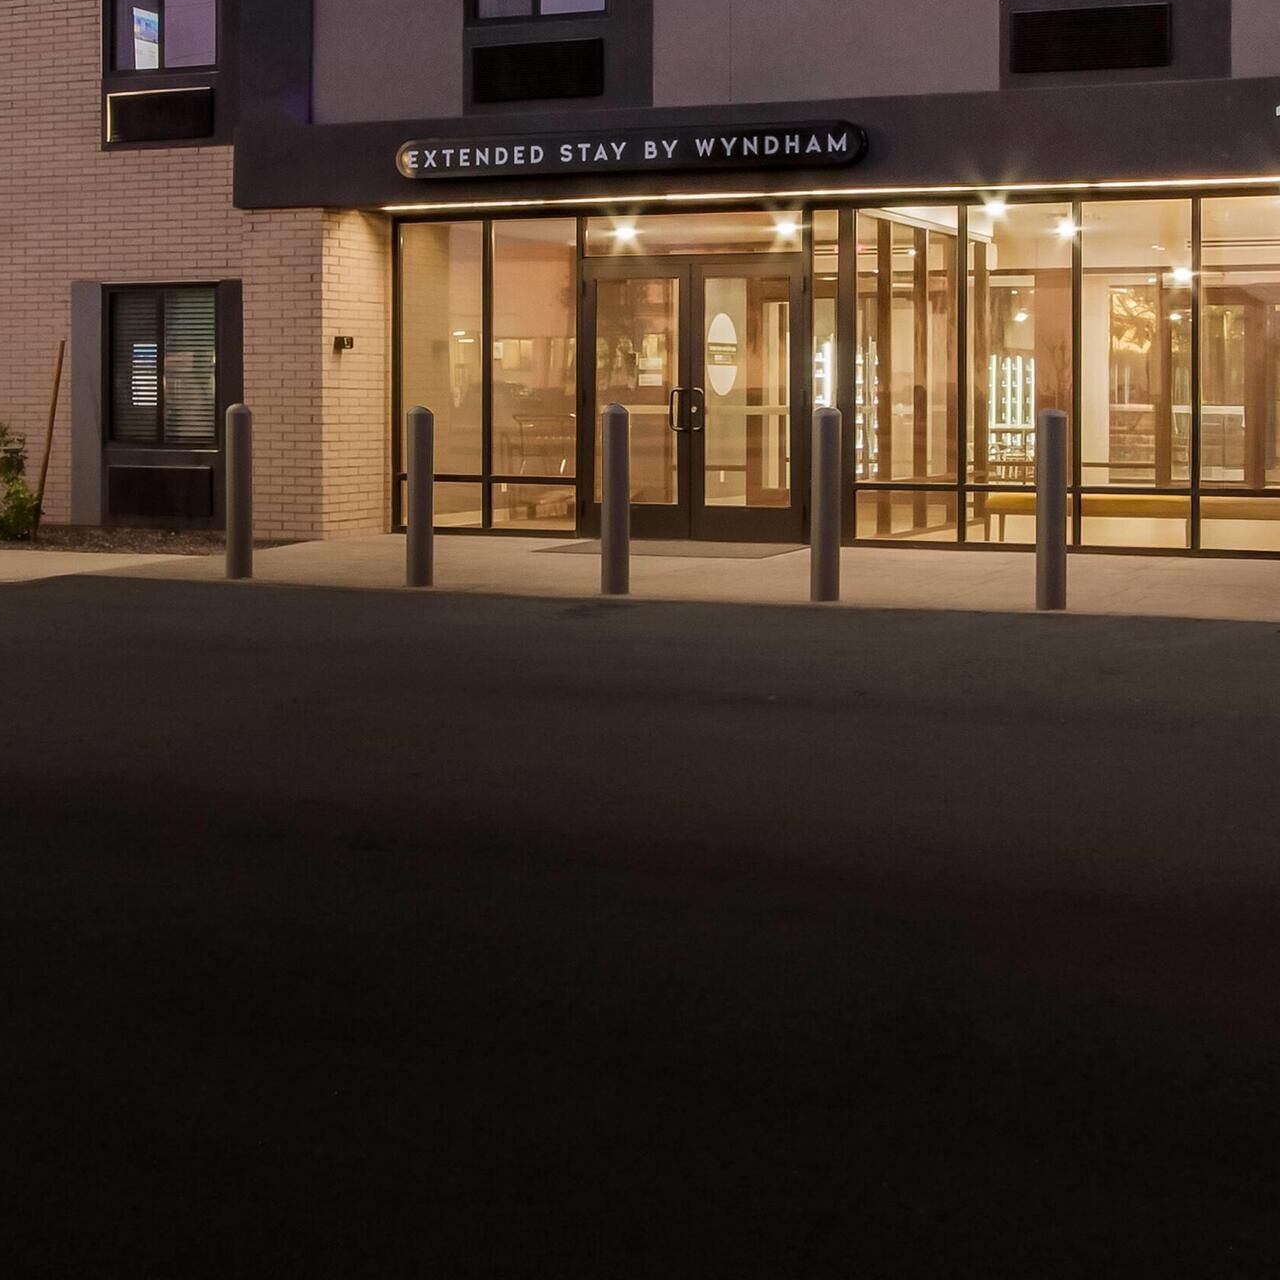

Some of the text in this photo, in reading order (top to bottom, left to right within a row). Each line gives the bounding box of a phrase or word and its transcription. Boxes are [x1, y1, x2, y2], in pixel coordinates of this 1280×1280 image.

[407, 132, 847, 169] EXTENDED STAY BY WYNDHAM
